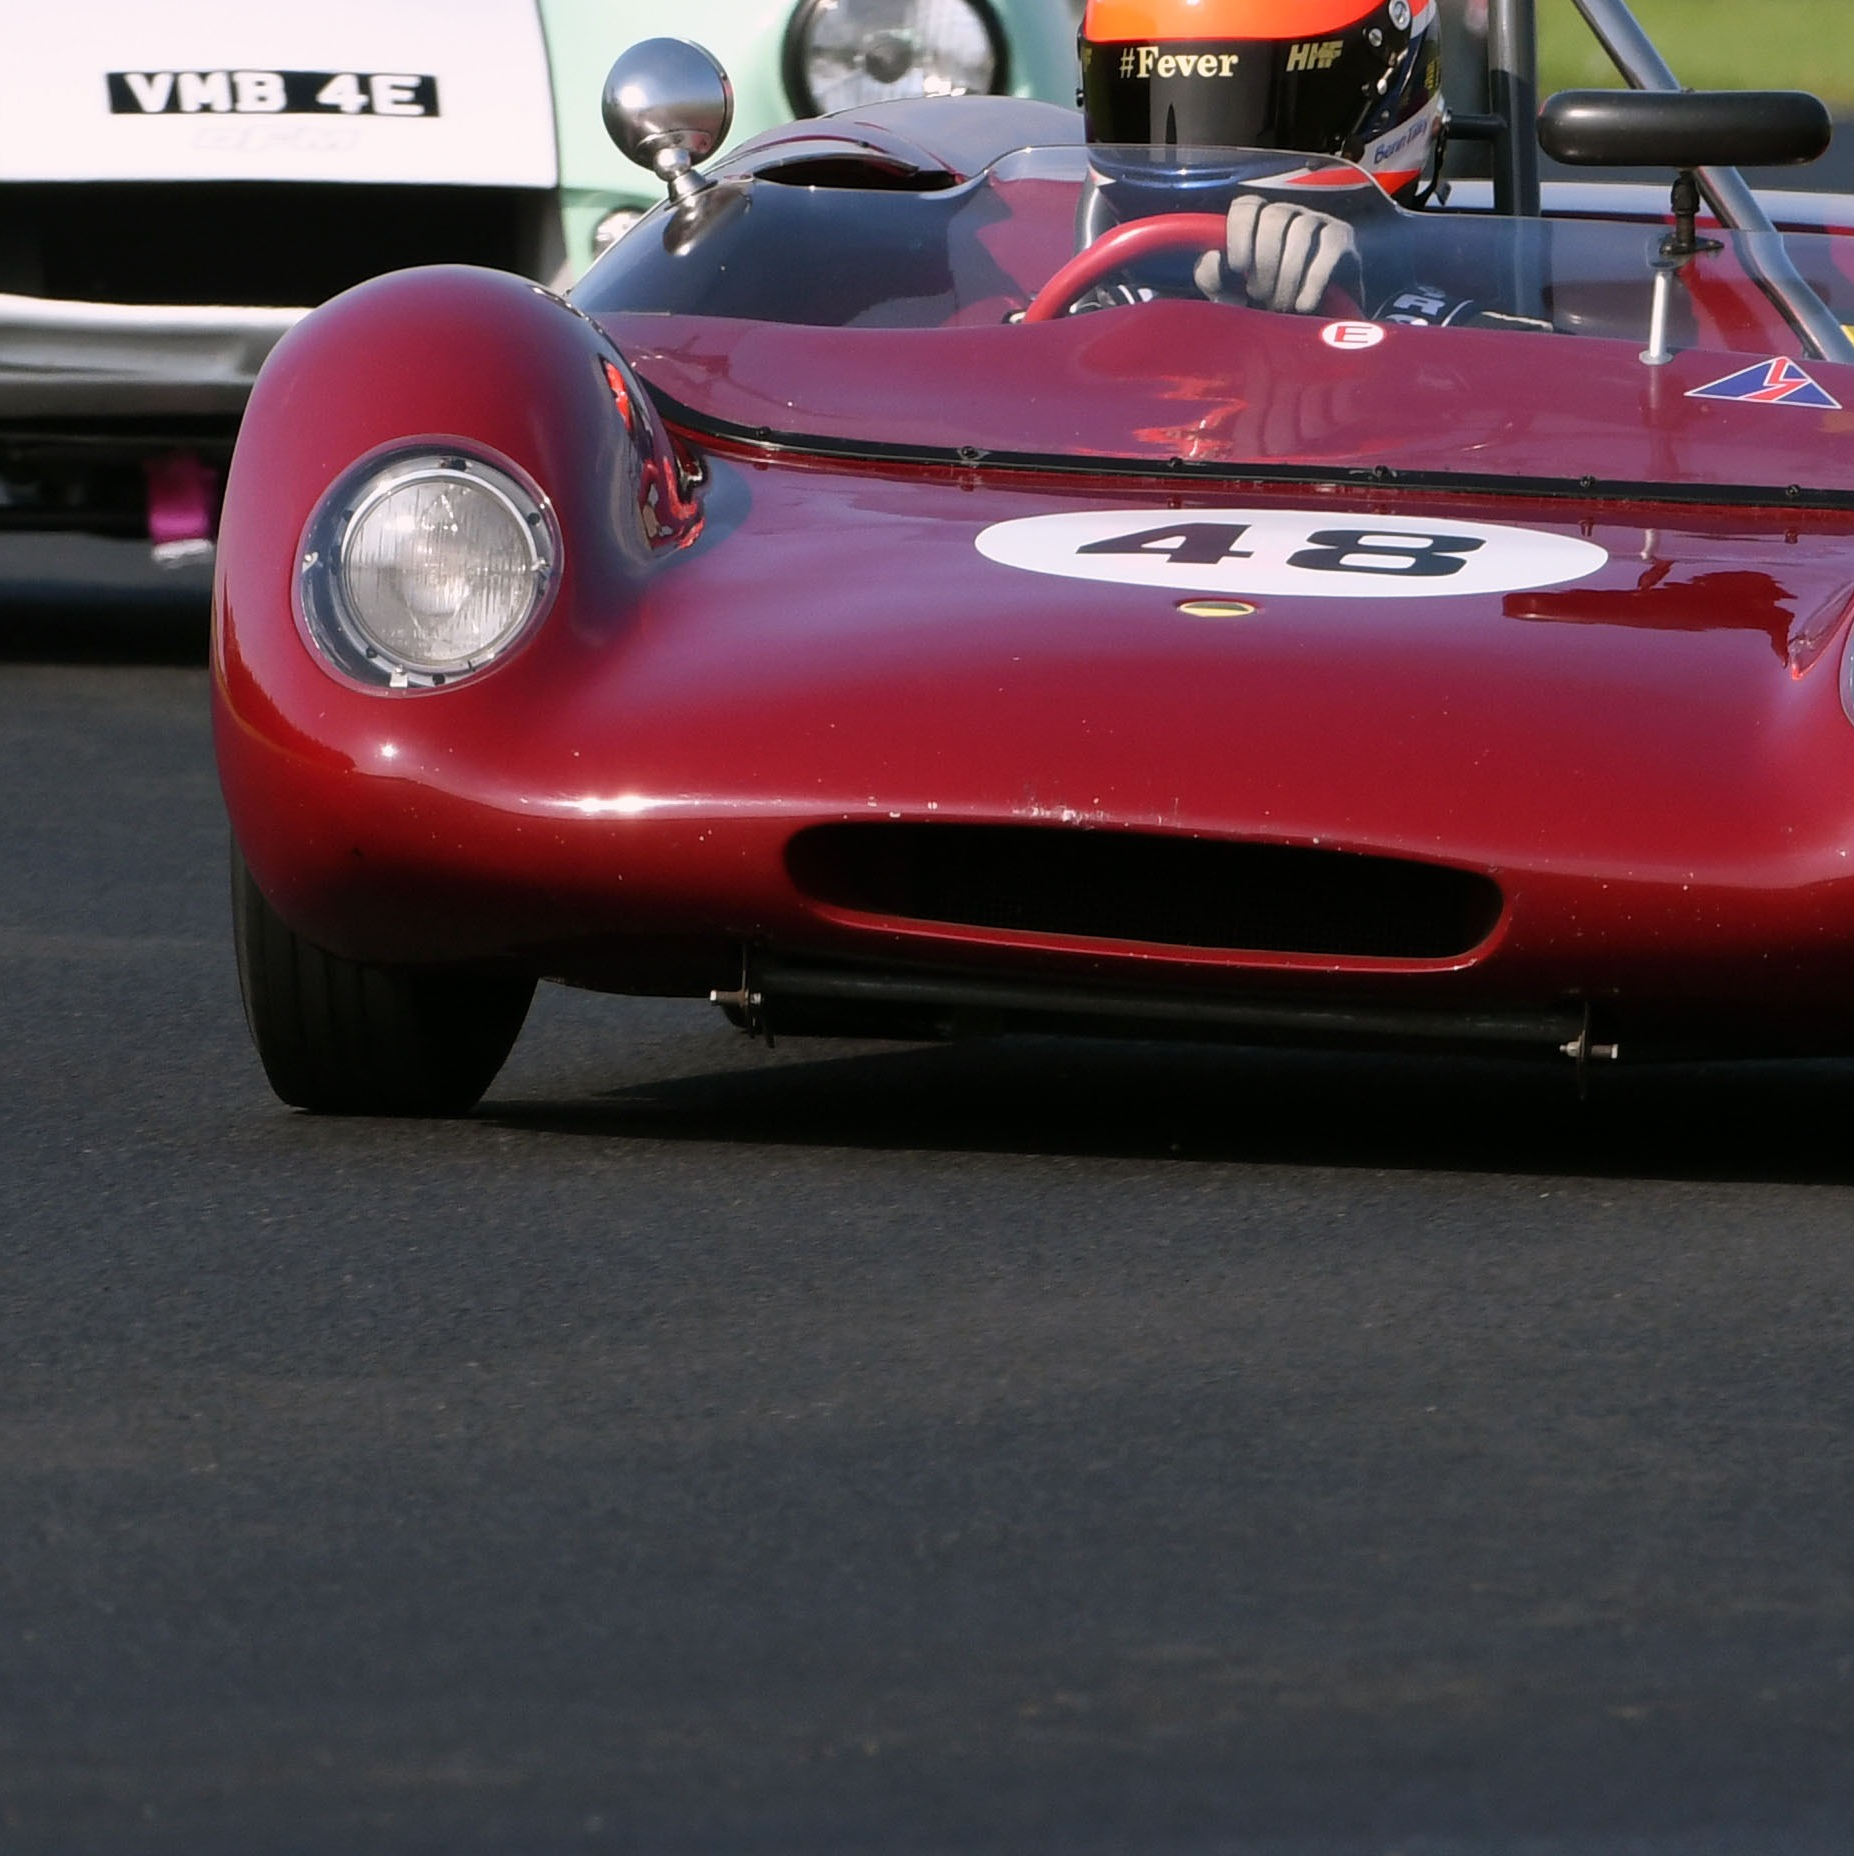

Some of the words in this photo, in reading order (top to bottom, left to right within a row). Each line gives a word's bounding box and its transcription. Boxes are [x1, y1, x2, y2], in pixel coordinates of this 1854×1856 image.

[1119, 45, 1239, 79] #Fever
[123, 70, 287, 113] VMB
[315, 73, 426, 116] 4E
[1334, 325, 1373, 344] E
[1075, 521, 1488, 578] 48
